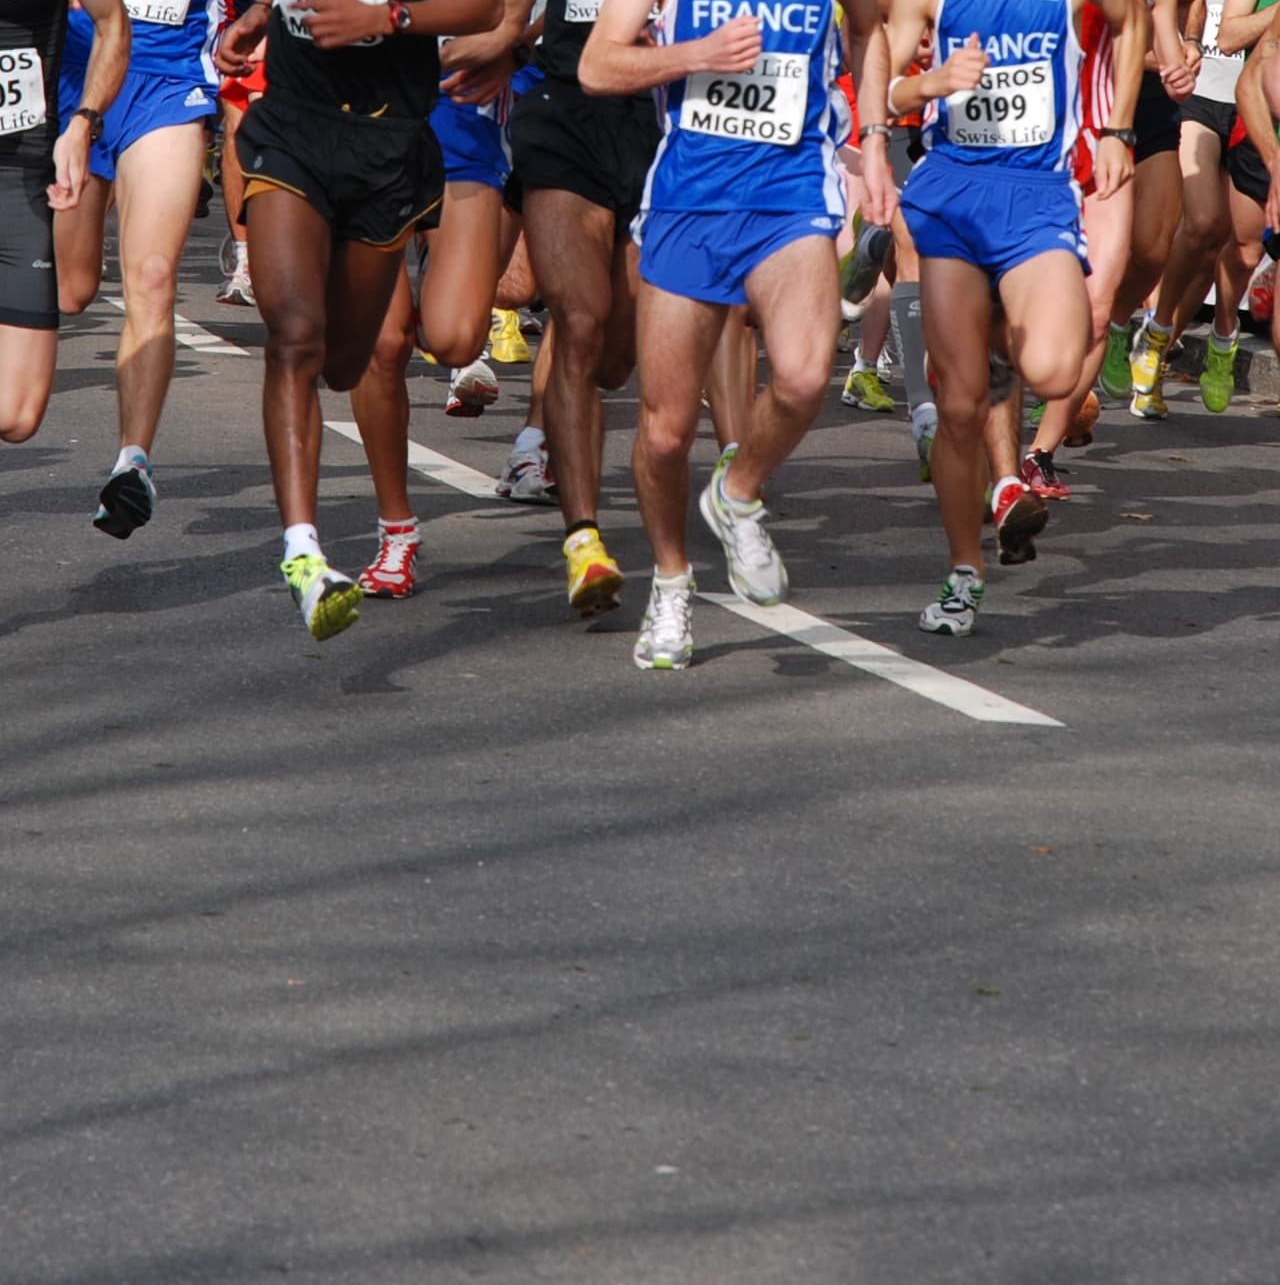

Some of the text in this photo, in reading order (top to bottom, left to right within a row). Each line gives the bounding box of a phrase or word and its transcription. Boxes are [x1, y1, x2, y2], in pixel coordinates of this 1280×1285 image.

[145, 4, 179, 22] Life
[568, 2, 600, 19] Swi
[761, 59, 802, 79] Life
[980, 66, 1046, 90] GROS
[706, 80, 776, 113] 6202
[965, 94, 1027, 122] 6199
[0, 109, 37, 131] Life
[691, 110, 792, 141] MIGROS
[955, 125, 1048, 144] Swiss Life
